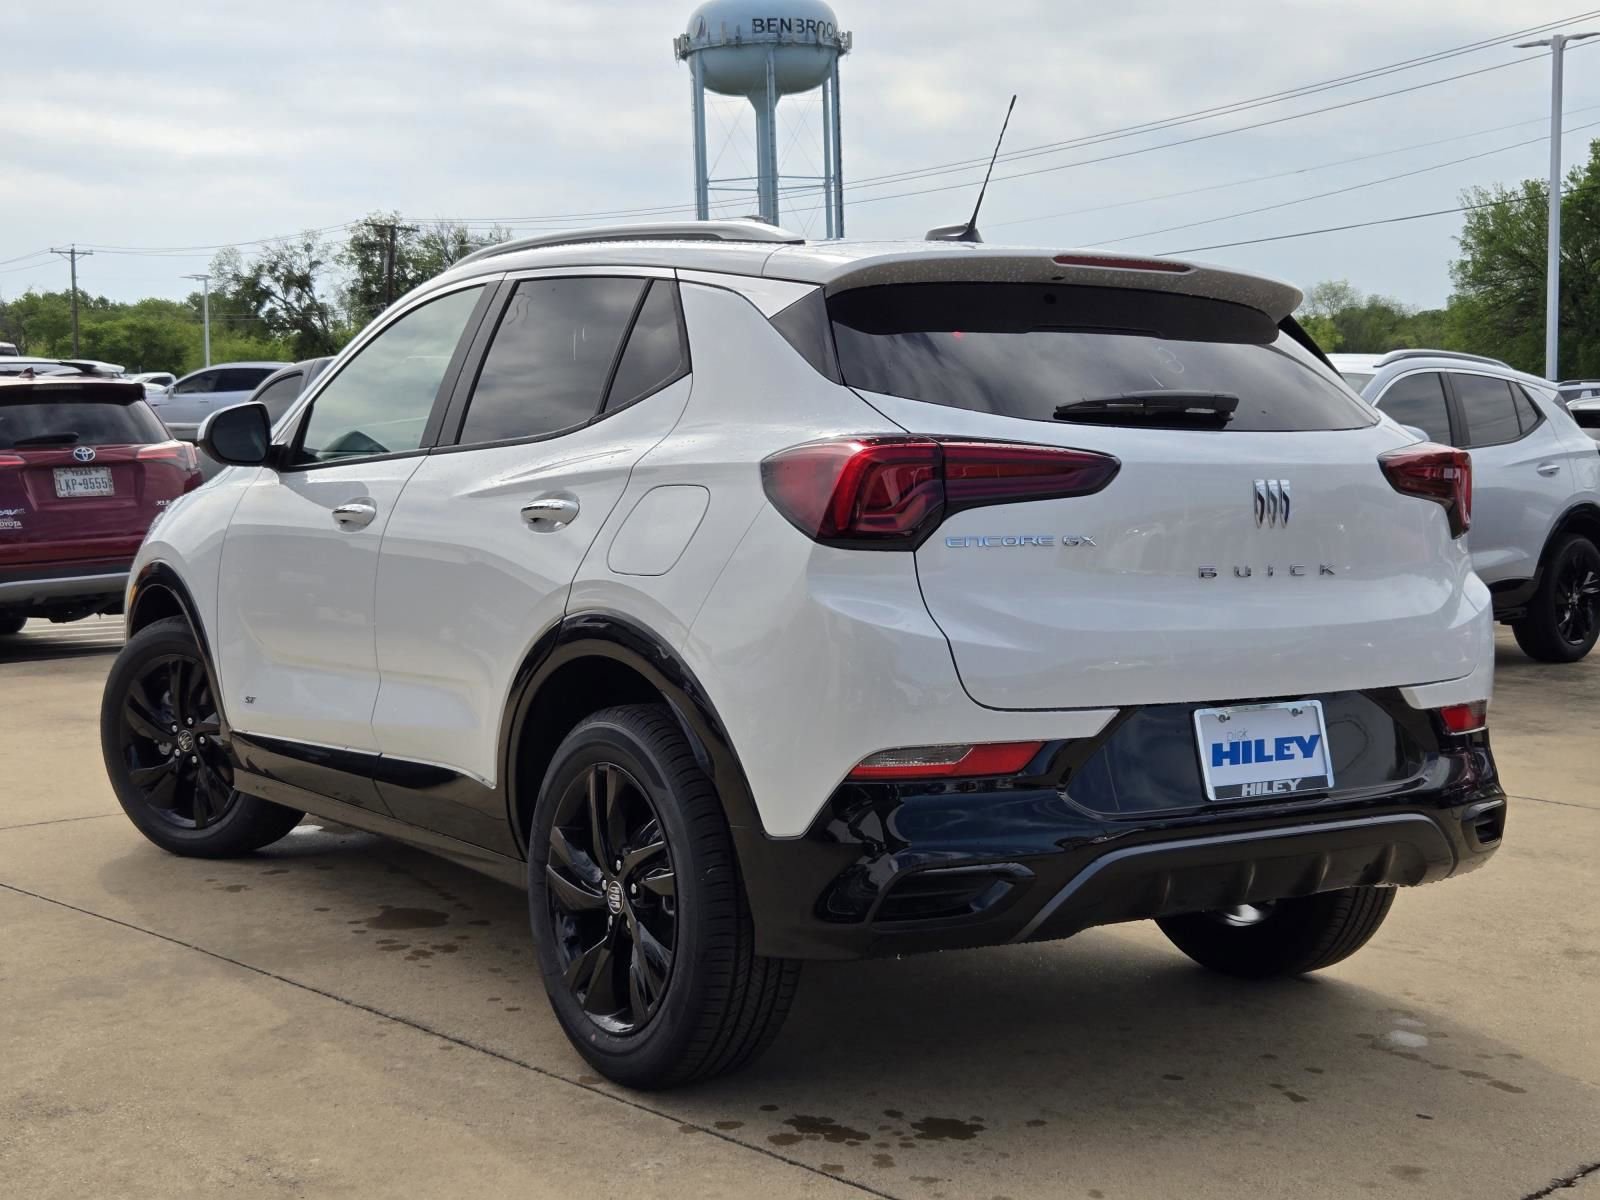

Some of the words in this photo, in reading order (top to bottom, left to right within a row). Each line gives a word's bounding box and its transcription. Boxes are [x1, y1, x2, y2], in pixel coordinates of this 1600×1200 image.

[945, 535, 1056, 548] ENCORE
[1061, 535, 1097, 547] GX
[1198, 563, 1336, 578] BUICK
[1211, 734, 1320, 768] HILEY
[1241, 777, 1302, 797] HILEY
